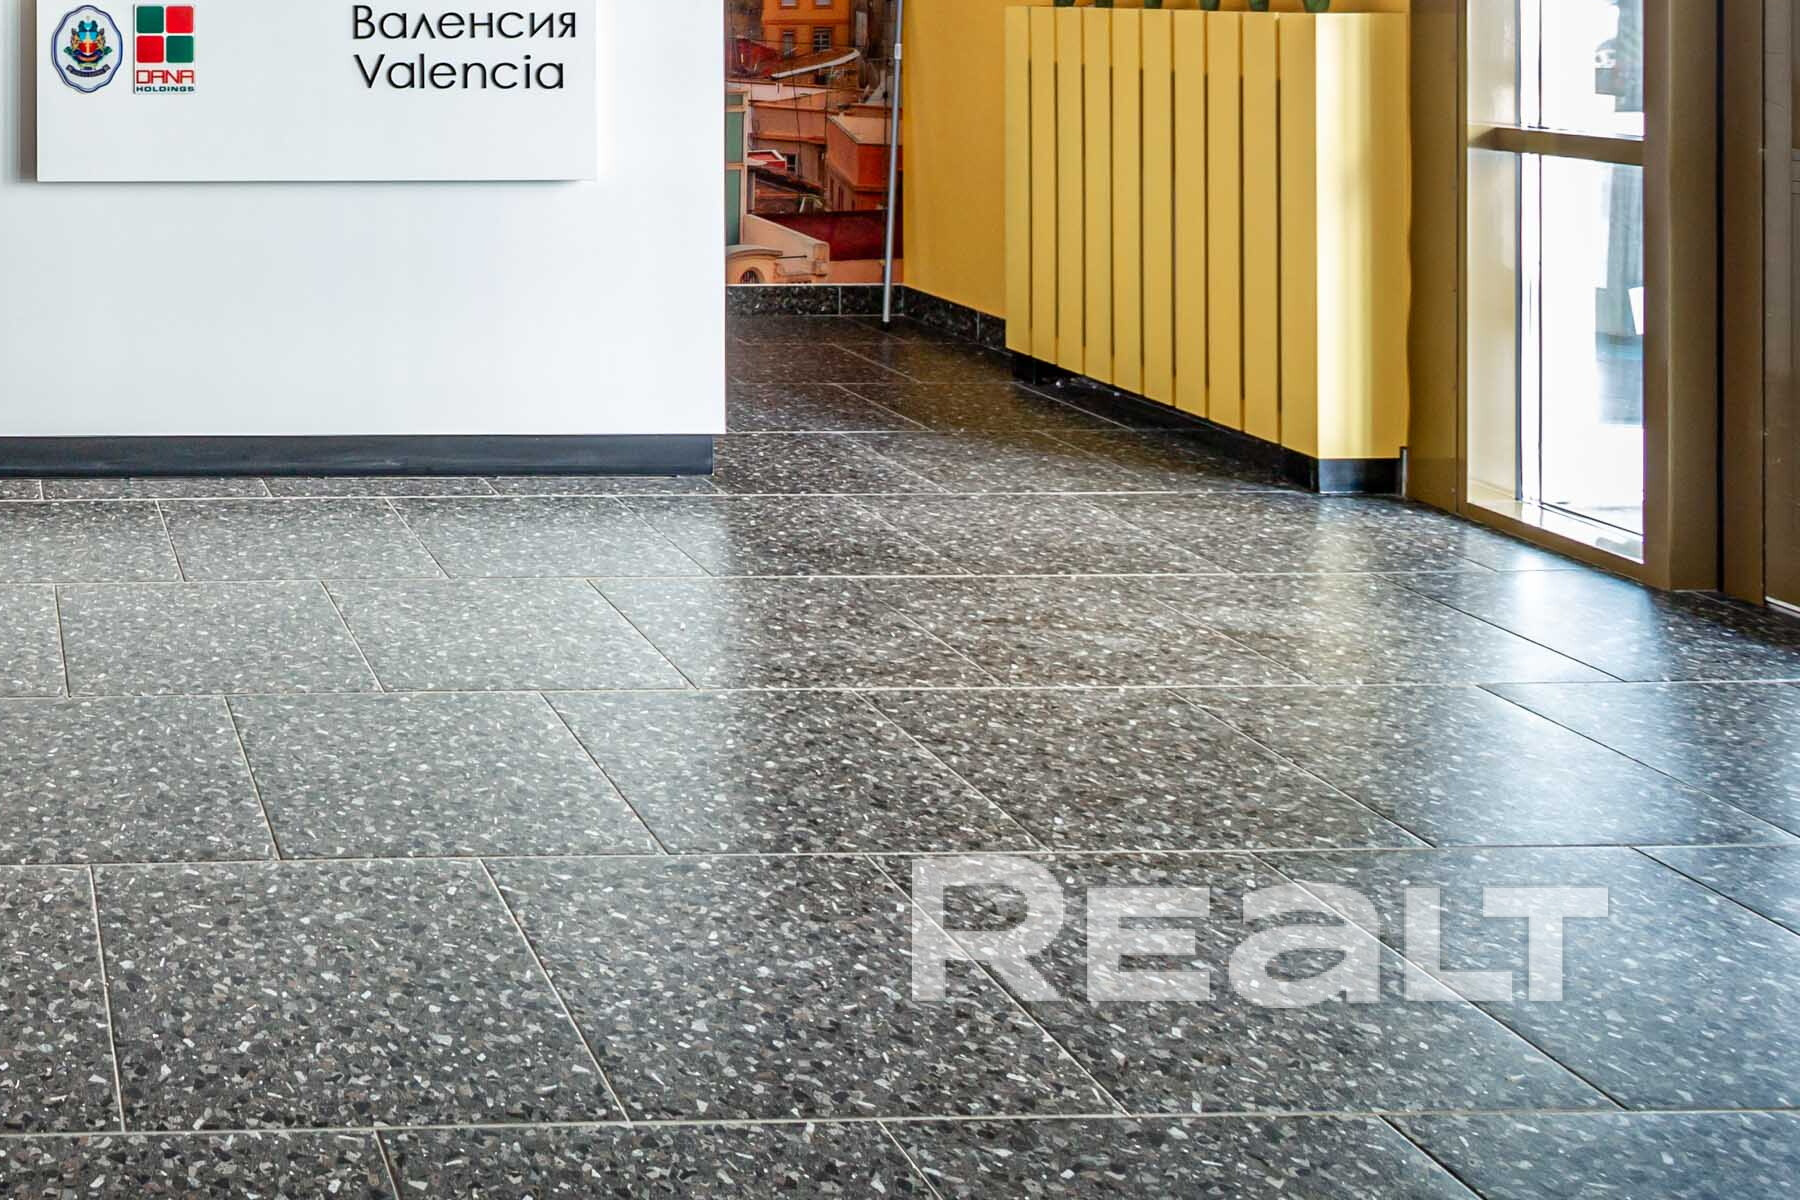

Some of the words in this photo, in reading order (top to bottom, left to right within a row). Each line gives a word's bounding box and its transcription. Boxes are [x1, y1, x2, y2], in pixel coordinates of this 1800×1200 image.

[352, 4, 577, 40] Валенсия
[135, 69, 195, 85] DANA
[353, 53, 565, 90] Valencia
[135, 85, 196, 93] HOLDINGS
